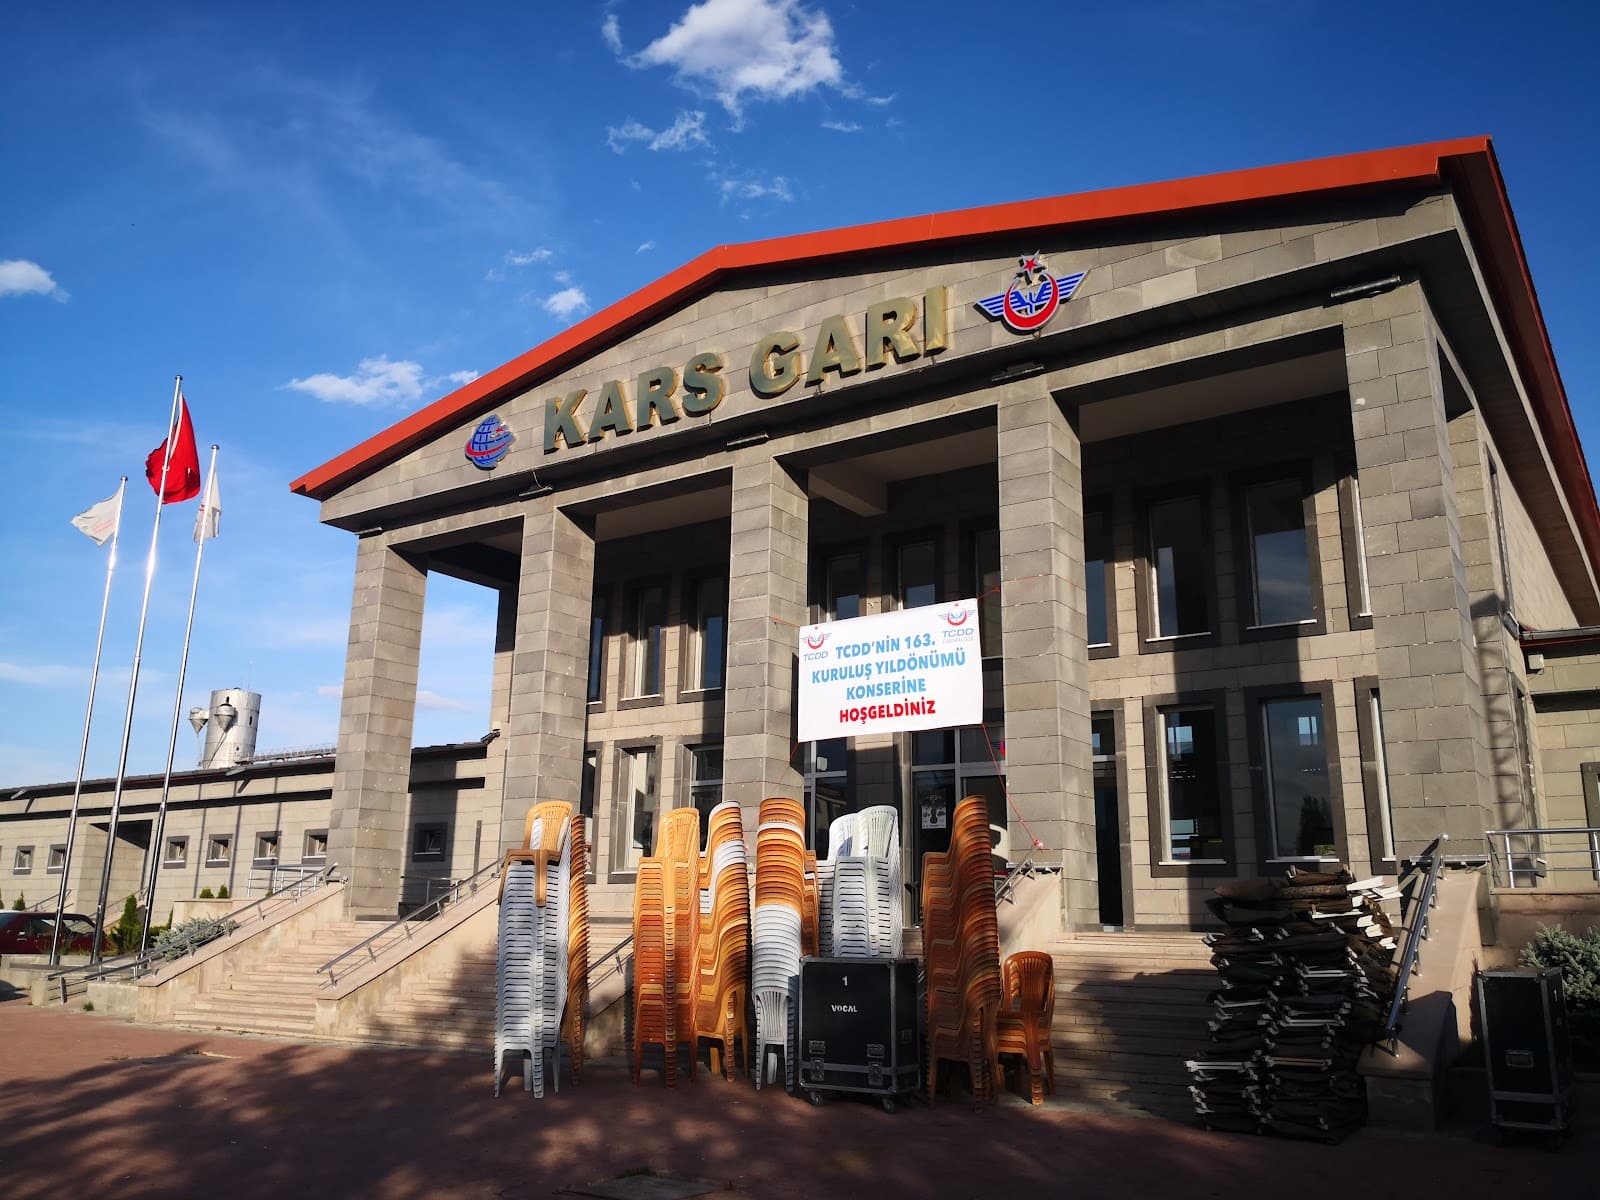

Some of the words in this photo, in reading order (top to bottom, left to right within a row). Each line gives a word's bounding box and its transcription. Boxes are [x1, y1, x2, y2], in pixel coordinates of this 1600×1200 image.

[544, 353, 725, 454] KARS
[749, 286, 947, 399] GARI
[943, 628, 974, 638] TCDD
[803, 651, 828, 661] TCDD
[836, 636, 899, 659] TCDD'NİN
[905, 633, 936, 649] 163.
[812, 662, 872, 683] KURULUŞ
[876, 648, 965, 675] YILDÖNÜMÜ
[847, 676, 926, 700] KONSERİNE
[840, 697, 936, 724] HOŞGELDİNİZ
[842, 976, 848, 986] 1
[832, 1005, 858, 1013] VOCAL
